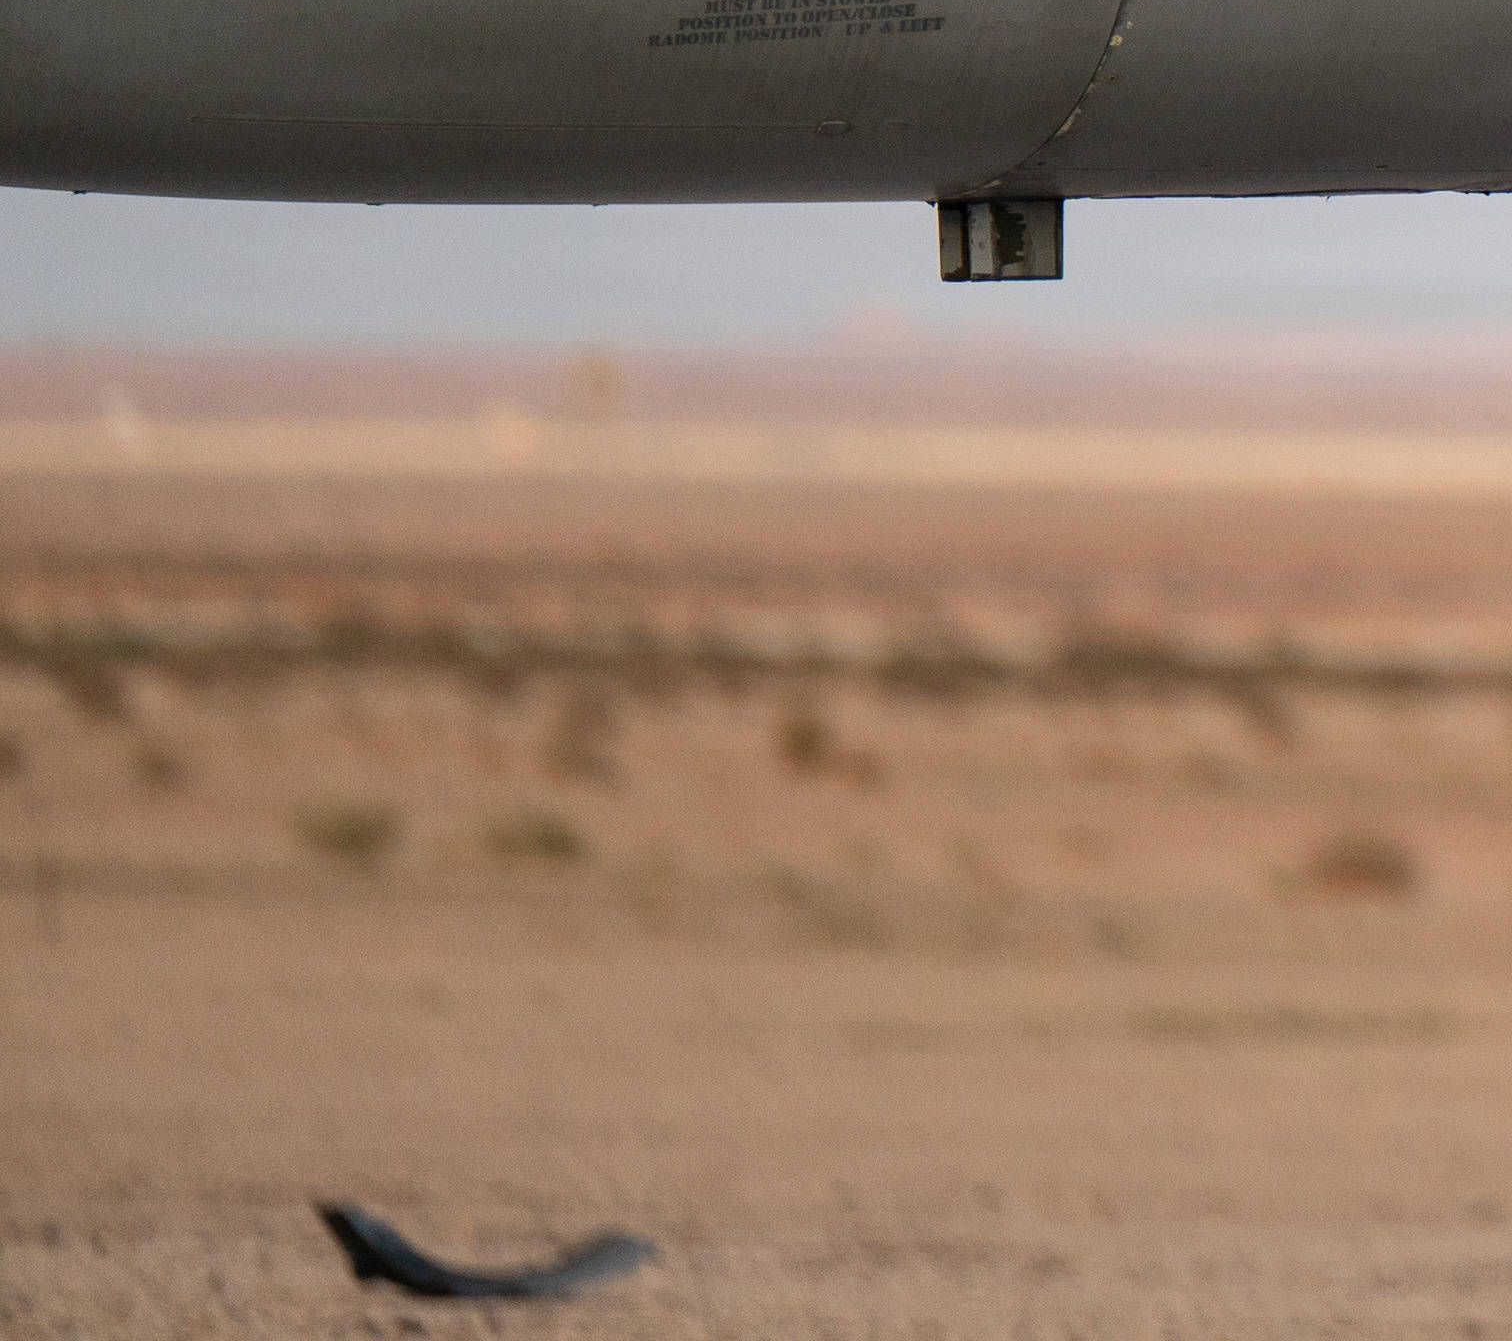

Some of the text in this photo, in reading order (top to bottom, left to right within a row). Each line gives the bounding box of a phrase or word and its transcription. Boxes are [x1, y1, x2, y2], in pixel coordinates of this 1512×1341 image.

[678, 4, 916, 31] POSITION TO OPEN/CLOSE
[648, 17, 946, 48] RADOME POSITION UP & LEFT
